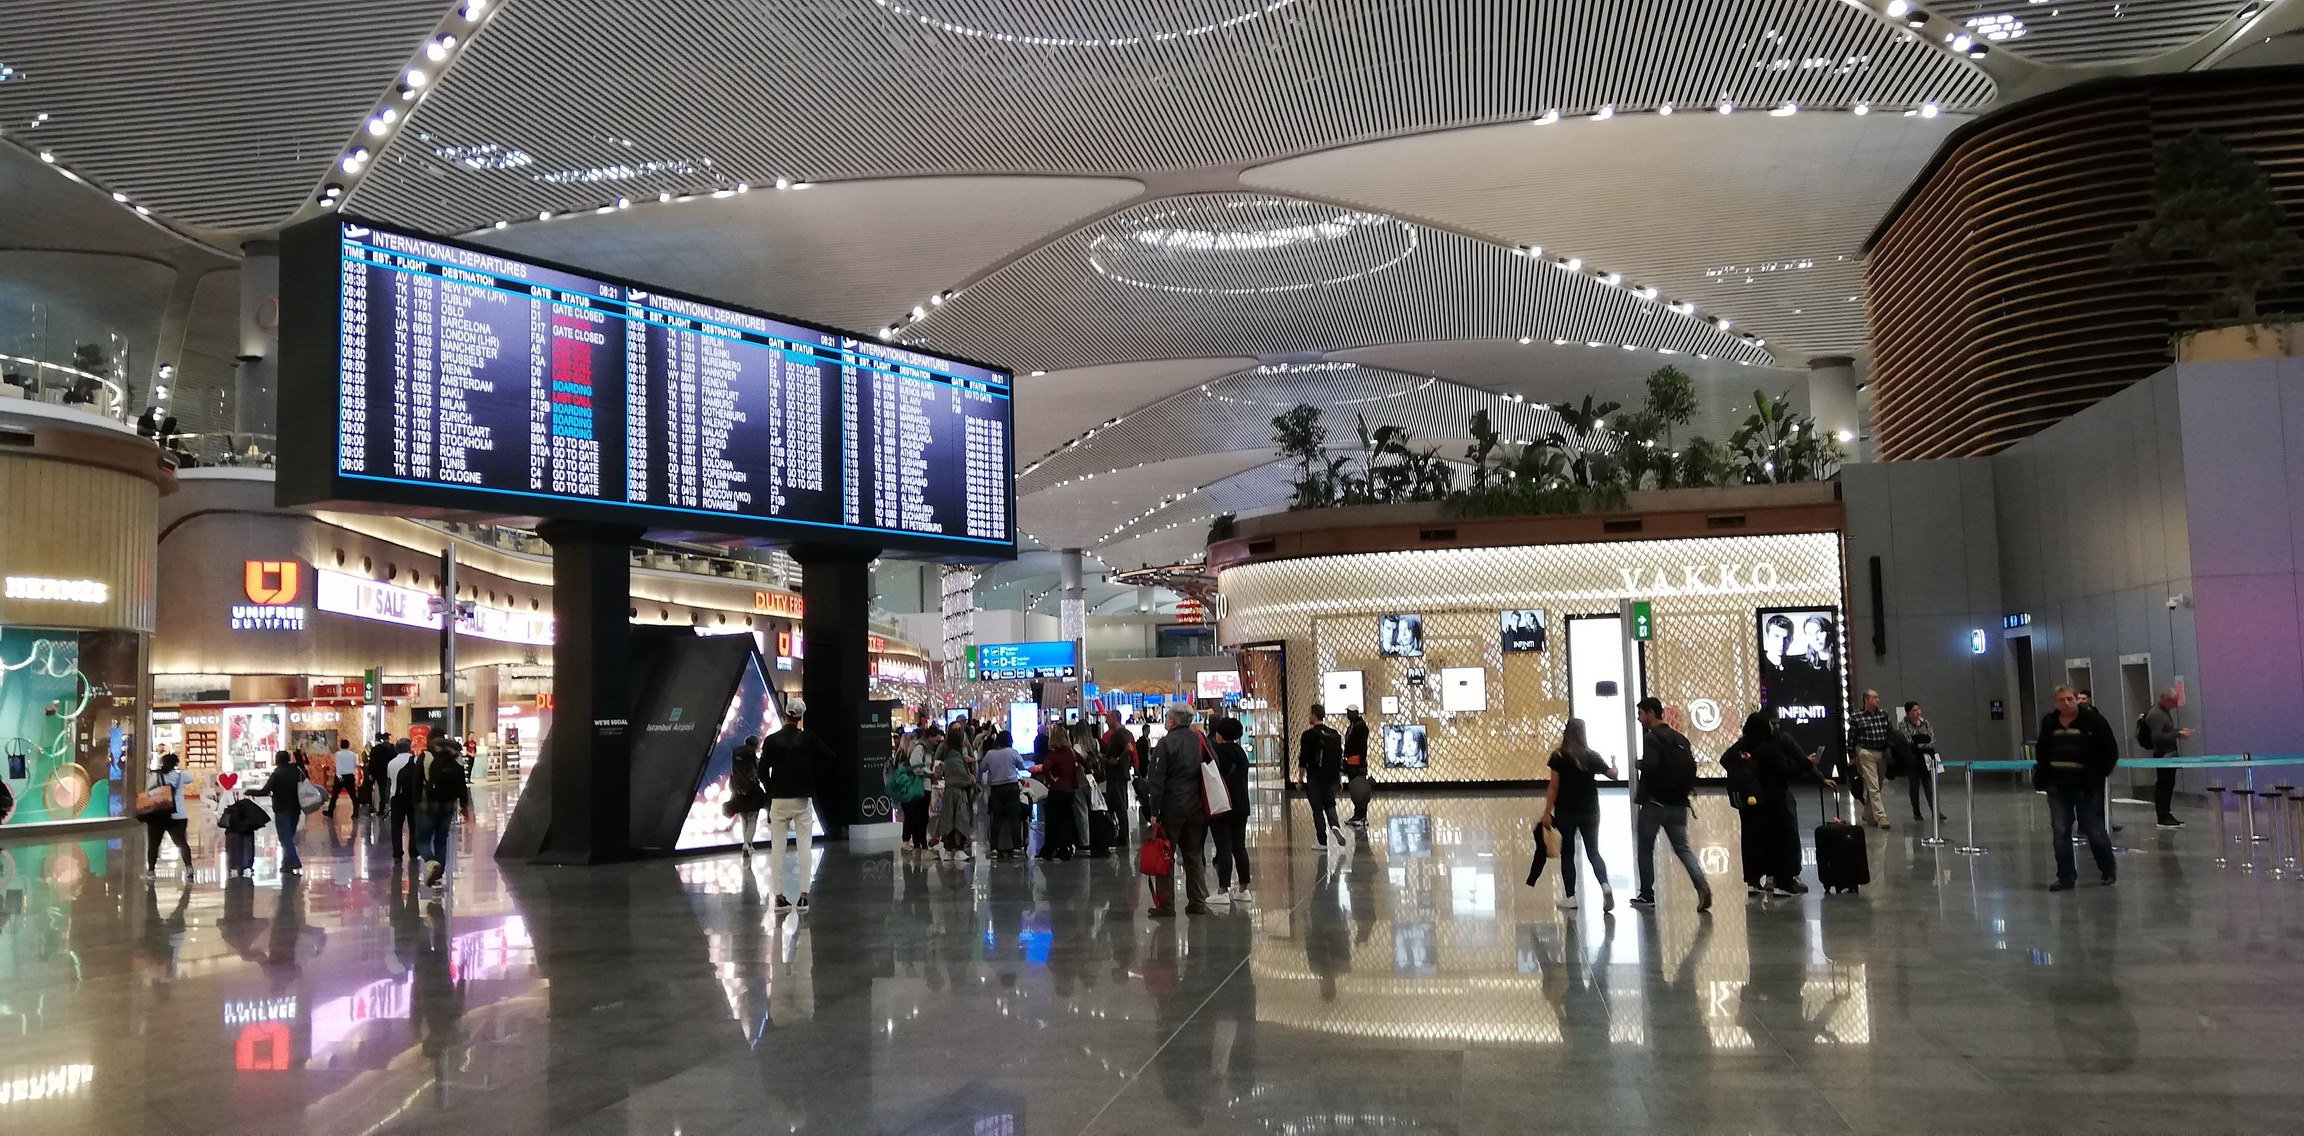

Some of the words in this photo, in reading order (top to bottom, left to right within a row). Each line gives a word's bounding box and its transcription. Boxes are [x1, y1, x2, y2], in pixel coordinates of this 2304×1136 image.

[344, 244, 365, 260] TIME
[397, 256, 427, 273] FLIGHT
[441, 265, 494, 287] DESTINATION
[530, 284, 551, 299] GATE
[561, 291, 589, 307] STATUS
[372, 230, 457, 263] INTERNATIONAL
[460, 250, 526, 278] DEPARTURES
[599, 284, 617, 299] 08:21
[343, 259, 366, 275] 08:35
[395, 270, 408, 284] AV
[440, 279, 461, 294] NEW
[463, 284, 485, 299] YORK
[487, 289, 506, 305] (JFK)
[552, 303, 572, 317] GATE
[574, 307, 604, 324] CLOSED
[343, 271, 366, 287] 08:35
[395, 282, 407, 295] TK
[440, 291, 471, 308] DUBLIN
[530, 309, 540, 322] D1
[343, 283, 366, 300] 08:40
[395, 294, 407, 307] TK
[440, 303, 464, 318] OSLO
[530, 320, 545, 334] D17
[552, 325, 572, 339] GATE
[574, 329, 604, 345] CLOSED
[343, 296, 366, 312] 08:40
[395, 306, 407, 319] TK
[440, 314, 491, 335] BARCELONA
[649, 293, 712, 319] INTERNATIONAL
[714, 308, 765, 331] DEPARTURES
[342, 320, 366, 336] 08:40
[395, 330, 407, 343] TK
[440, 338, 497, 359] MANCHESTER
[343, 308, 366, 324] 08:40
[395, 318, 407, 331] UA
[440, 326, 476, 344] LONDON
[478, 333, 499, 349] (LHR)
[628, 306, 644, 319] TIME
[667, 315, 690, 329] FLIGHT
[701, 322, 741, 340] DESTINATION
[768, 336, 784, 349] GATE
[791, 342, 813, 355] STATUS
[342, 333, 366, 348] 08:45
[394, 342, 407, 355] TK
[440, 350, 484, 368] BRUSSELS
[701, 354, 741, 372] NUREMBERG
[858, 341, 908, 362] INTERNATIONAL
[909, 352, 949, 372] DEPARTURES
[342, 345, 366, 361] 08:50
[394, 354, 407, 367] TK
[440, 362, 472, 378] VIENNA
[552, 380, 592, 397] BOARDING
[342, 358, 366, 373] 08:50
[394, 366, 407, 379] TK
[440, 373, 492, 392] AMSTERDAM
[701, 365, 736, 381] HANNOVER
[701, 375, 727, 389] GENEVA
[342, 370, 365, 385] 08:55
[394, 378, 404, 391] J2
[440, 385, 463, 400] BAKU
[552, 402, 592, 419] BOARDING
[342, 382, 365, 398] 08:55
[394, 390, 406, 403] TK
[440, 397, 465, 412] MILAN
[552, 414, 592, 430] BOARDING
[701, 385, 738, 401] FRANKFURT
[701, 395, 733, 410] HAMBURG
[964, 389, 972, 399] GO
[972, 391, 979, 400] TO
[980, 392, 992, 403] GATE
[342, 395, 365, 410] 08:55
[394, 402, 406, 415] TK
[440, 409, 471, 424] ZURICH
[552, 425, 592, 441] BOARDING
[701, 405, 746, 422] GOTHENBURG
[702, 416, 733, 430] VALENCIA
[341, 420, 365, 434] 09:00
[394, 427, 406, 440] TK
[440, 432, 492, 450] STOCKHOLM
[530, 444, 550, 457] B12A
[552, 447, 564, 459] GO
[566, 449, 577, 461] TO
[578, 450, 598, 463] GATE
[342, 407, 365, 422] 09:00
[394, 414, 406, 428] TK
[440, 421, 490, 438] STUTTGART
[552, 436, 564, 448] GO
[566, 438, 577, 450] TO
[578, 439, 598, 452] GATE
[702, 426, 728, 439] MALAGA
[702, 436, 726, 449] LEIPZIG
[341, 432, 365, 447] 09:00
[394, 439, 406, 452] TK
[439, 444, 464, 458] ROME
[530, 456, 544, 468] D11
[552, 458, 564, 470] GO
[566, 460, 577, 472] TO
[578, 461, 598, 474] GATE
[341, 445, 365, 459] 09:05
[394, 451, 406, 464] TK
[439, 456, 465, 470] TUNIS
[530, 467, 542, 479] C4
[552, 469, 564, 481] GO
[566, 471, 577, 483] TO
[578, 472, 598, 485] GATE
[702, 446, 719, 458] LYON
[702, 456, 733, 470] BOLOGNA
[341, 457, 364, 472] 09:05
[393, 463, 406, 476] TK
[439, 468, 481, 484] COLOGNE
[530, 478, 542, 490] D4
[552, 481, 564, 492] GO
[566, 482, 577, 494] TO
[578, 483, 598, 496] GATE
[702, 467, 746, 482] COPENHAGEN
[702, 477, 728, 490] TALLINN
[702, 487, 732, 500] MOSCOW
[702, 497, 737, 511] ROVANIEMI
[1619, 562, 1778, 596] VAKKO
[232, 606, 304, 620] UNIFREE
[376, 588, 407, 618] SALE
[755, 592, 788, 612] DUTY
[1000, 646, 1006, 656] F
[184, 716, 220, 725] GUCCI
[290, 712, 340, 723] GUCCI
[646, 723, 672, 732] Istanbul
[672, 722, 695, 732] Airport
[1778, 706, 1826, 718] INFINITI
